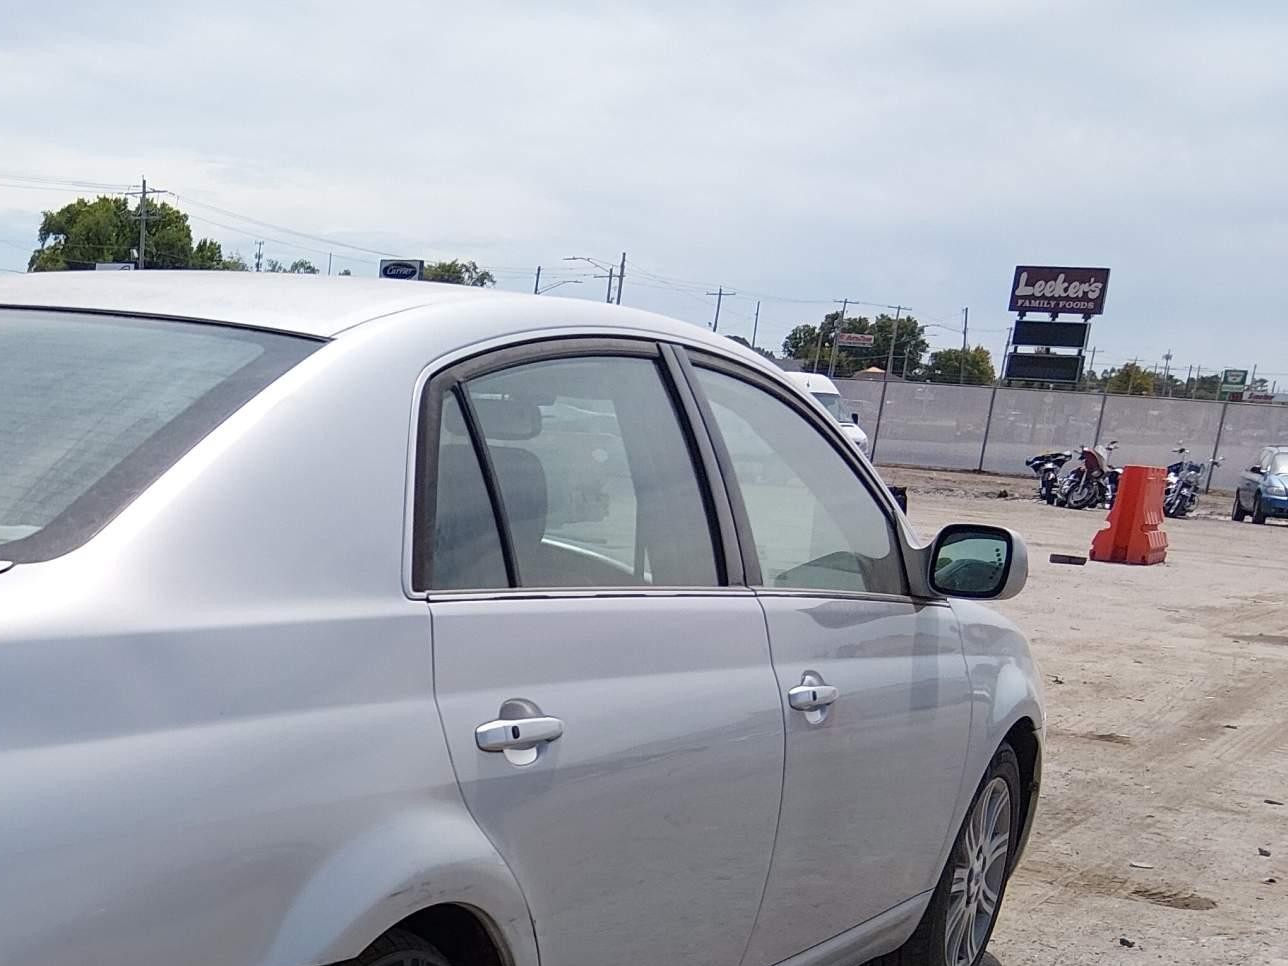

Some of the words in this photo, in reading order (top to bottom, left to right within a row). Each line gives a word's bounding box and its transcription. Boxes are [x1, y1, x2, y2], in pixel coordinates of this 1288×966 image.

[1016, 272, 1103, 299] Leeker's
[1016, 299, 1057, 309] FAMILY
[1059, 300, 1095, 310] FOODS
